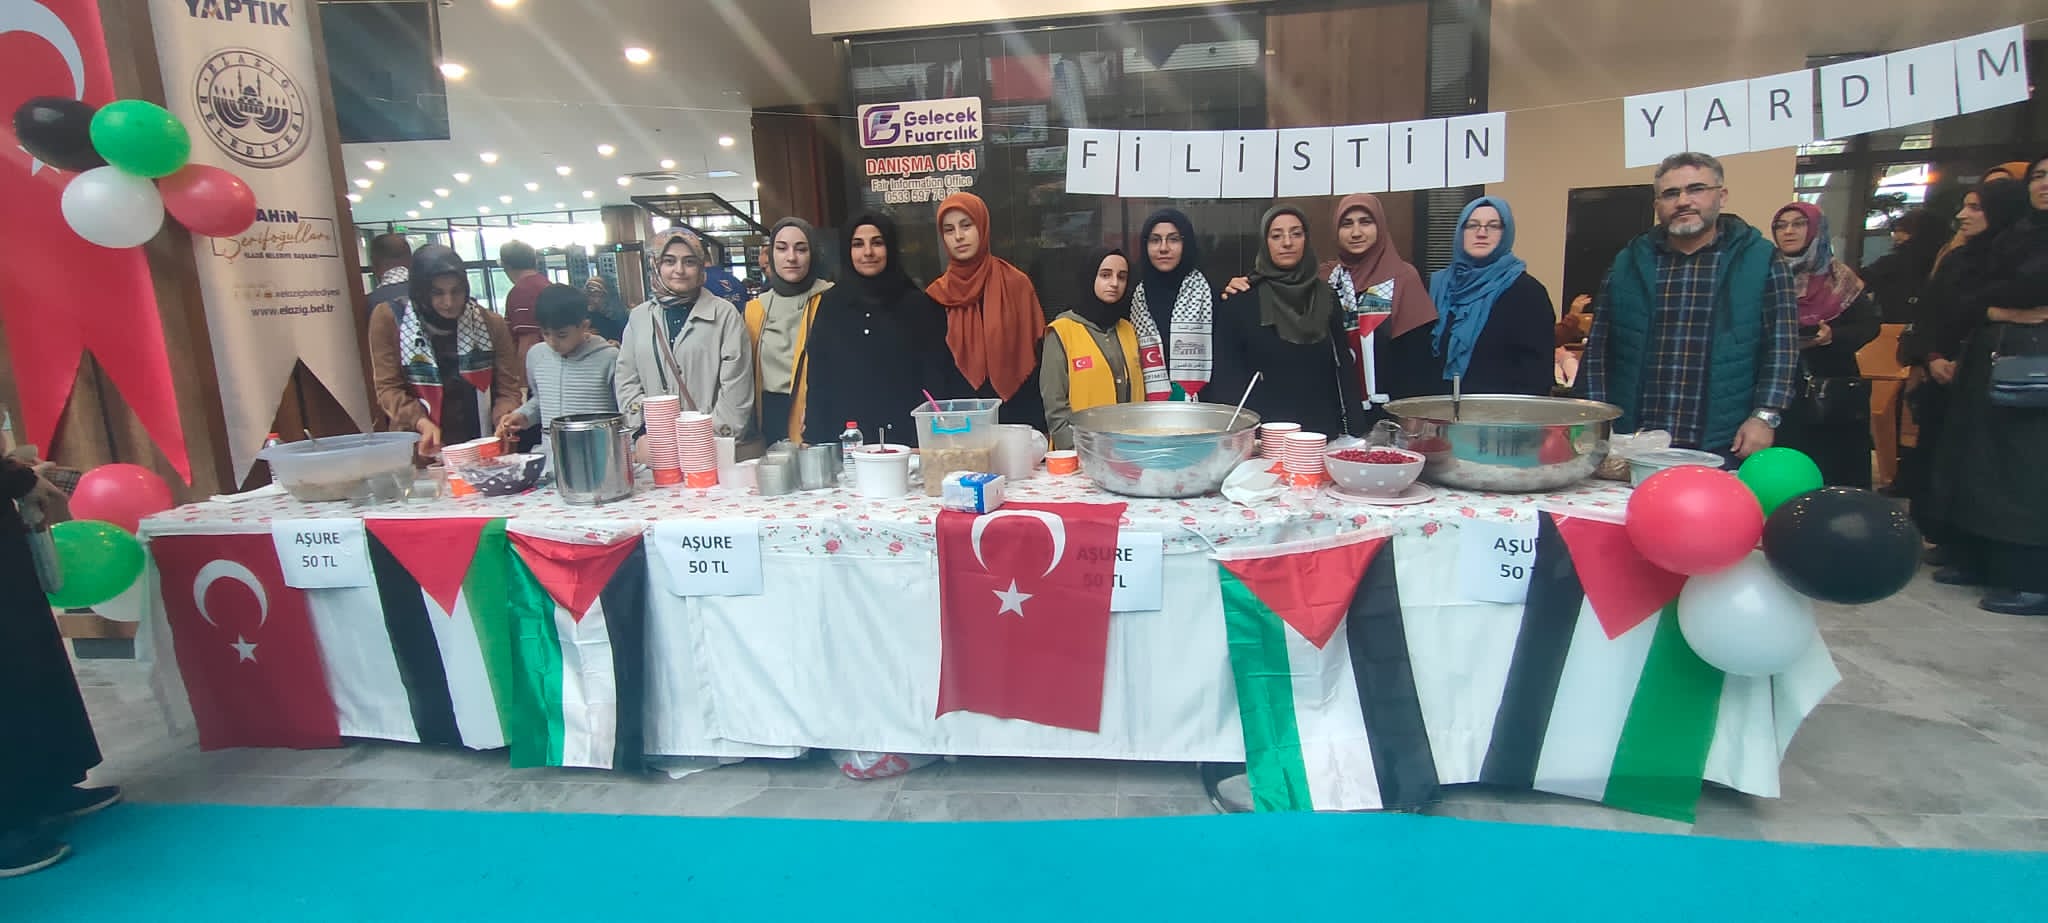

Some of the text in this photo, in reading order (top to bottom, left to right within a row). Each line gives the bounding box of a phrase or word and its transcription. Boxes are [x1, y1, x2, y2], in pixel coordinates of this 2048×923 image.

[184, 0, 290, 27] YAPTIK
[1641, 40, 2019, 138] YARDIM
[904, 106, 977, 126] Gelecek
[905, 125, 978, 143] Fuarcılık
[1081, 127, 1489, 173] FİLİSTİN
[866, 149, 976, 177] DANIŞMA OFİSİ
[872, 175, 973, 191] Fair Information Office
[886, 191, 909, 203] 0533
[295, 532, 341, 548] AŞURE
[681, 535, 733, 552] AŞURE
[302, 555, 338, 568] 50 TL
[688, 560, 729, 574] 50 TL
[1500, 563, 1524, 580] 50
